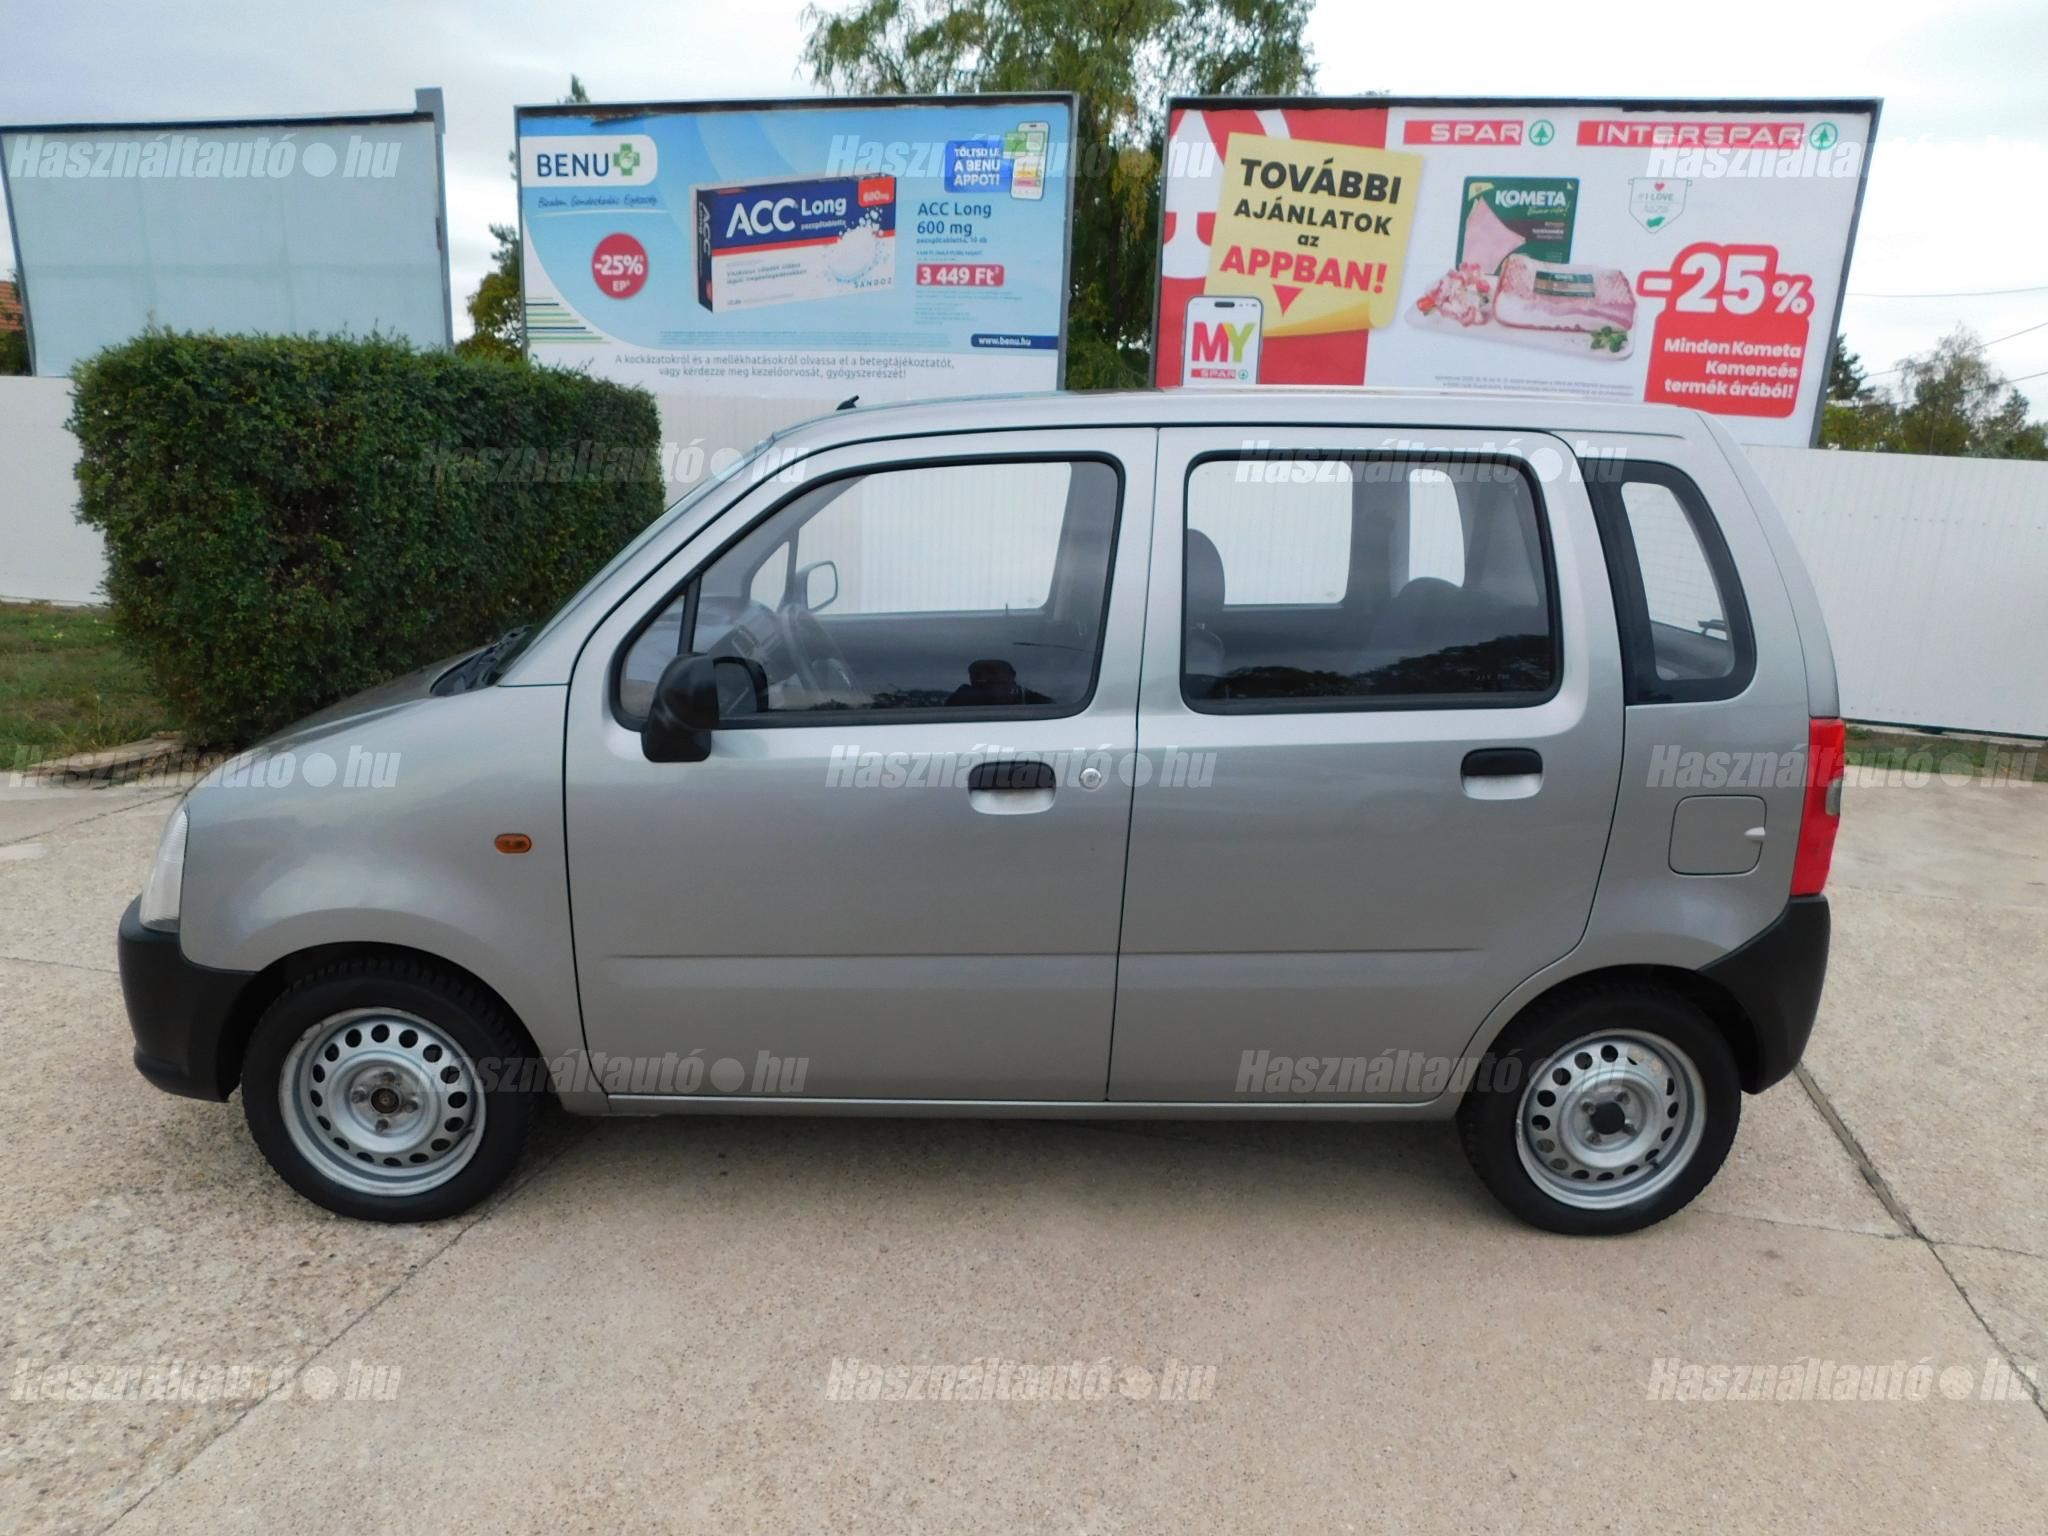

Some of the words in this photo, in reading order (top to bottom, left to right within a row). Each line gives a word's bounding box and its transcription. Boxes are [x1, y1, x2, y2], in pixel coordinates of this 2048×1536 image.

[1430, 123, 1522, 143] SPAR
[1596, 124, 1801, 146] INTERSPAR
[954, 146, 988, 157] TÖLTSD
[537, 153, 610, 177] BENU
[954, 161, 964, 172] A
[966, 159, 1000, 172] BENU
[1239, 157, 1402, 204] TOVÁBBI
[1495, 189, 1567, 208] KOMETA
[1651, 192, 1673, 201] LOVE
[726, 198, 797, 239] ACC
[801, 196, 847, 216] Long
[917, 202, 949, 217] ACC
[954, 202, 992, 218] Long
[1233, 195, 1393, 236] AJÁNLATOK
[917, 220, 945, 234] 600
[949, 223, 972, 237] mg
[1297, 233, 1320, 247] az
[921, 266, 932, 285] 3
[936, 266, 970, 285] 449
[1219, 245, 1388, 294] APPBAN!
[853, 276, 893, 289] SANDOZ
[1643, 251, 1808, 315] -25%
[978, 336, 1032, 347] www.benu.hu
[1191, 321, 1256, 364] MY
[1664, 338, 1730, 355] Minden
[1732, 341, 1802, 358] Kometa
[615, 354, 622, 364] A
[625, 353, 690, 364] kockázatokról
[692, 354, 703, 364] és
[705, 356, 711, 365] a
[714, 353, 798, 365] mellékhatásokról
[800, 355, 836, 365] olvassa
[839, 355, 849, 366] el
[851, 357, 857, 366] a
[659, 367, 681, 378] vagy
[683, 366, 726, 376] kérdezze
[728, 368, 749, 378] meg
[1200, 368, 1237, 379] SPAR
[1705, 360, 1798, 379] Kemencés
[1664, 378, 1728, 396] termék
[1729, 381, 1794, 399] árából!
